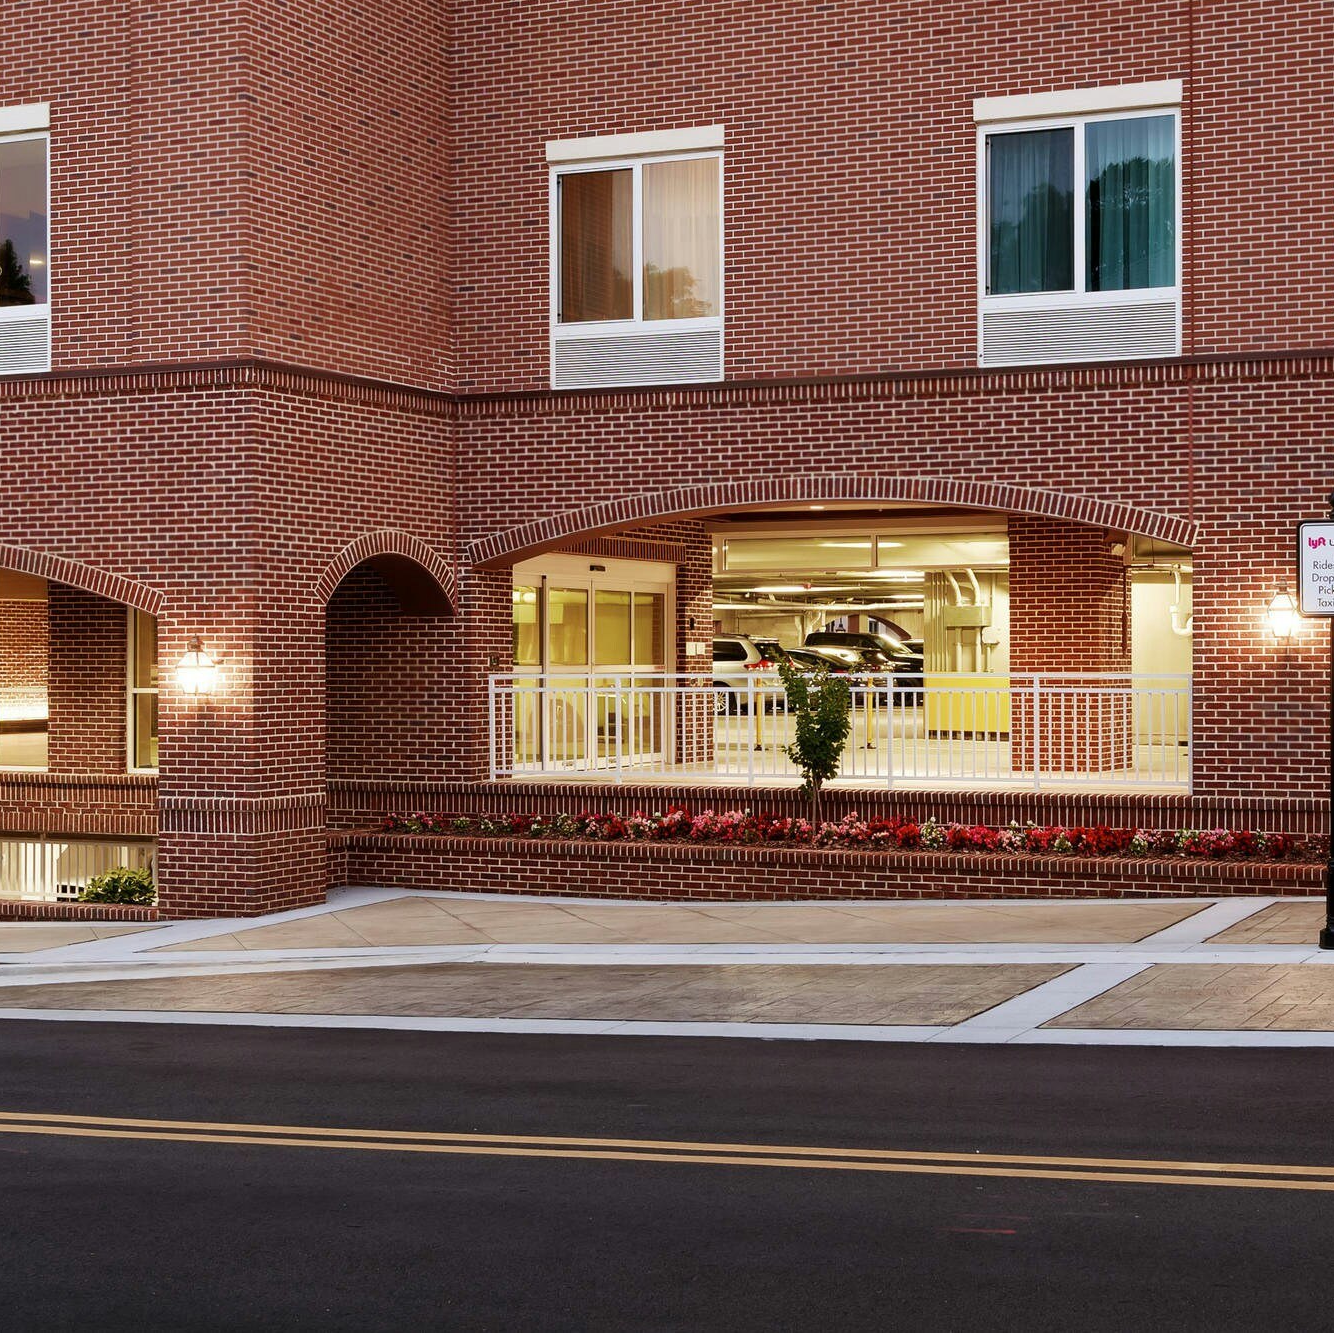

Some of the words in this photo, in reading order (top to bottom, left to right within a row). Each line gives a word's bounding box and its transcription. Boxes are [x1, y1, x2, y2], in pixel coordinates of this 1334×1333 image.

[1308, 537, 1326, 549] lyft
[1312, 573, 1334, 584] Drop
[1317, 597, 1334, 607] Taxi
